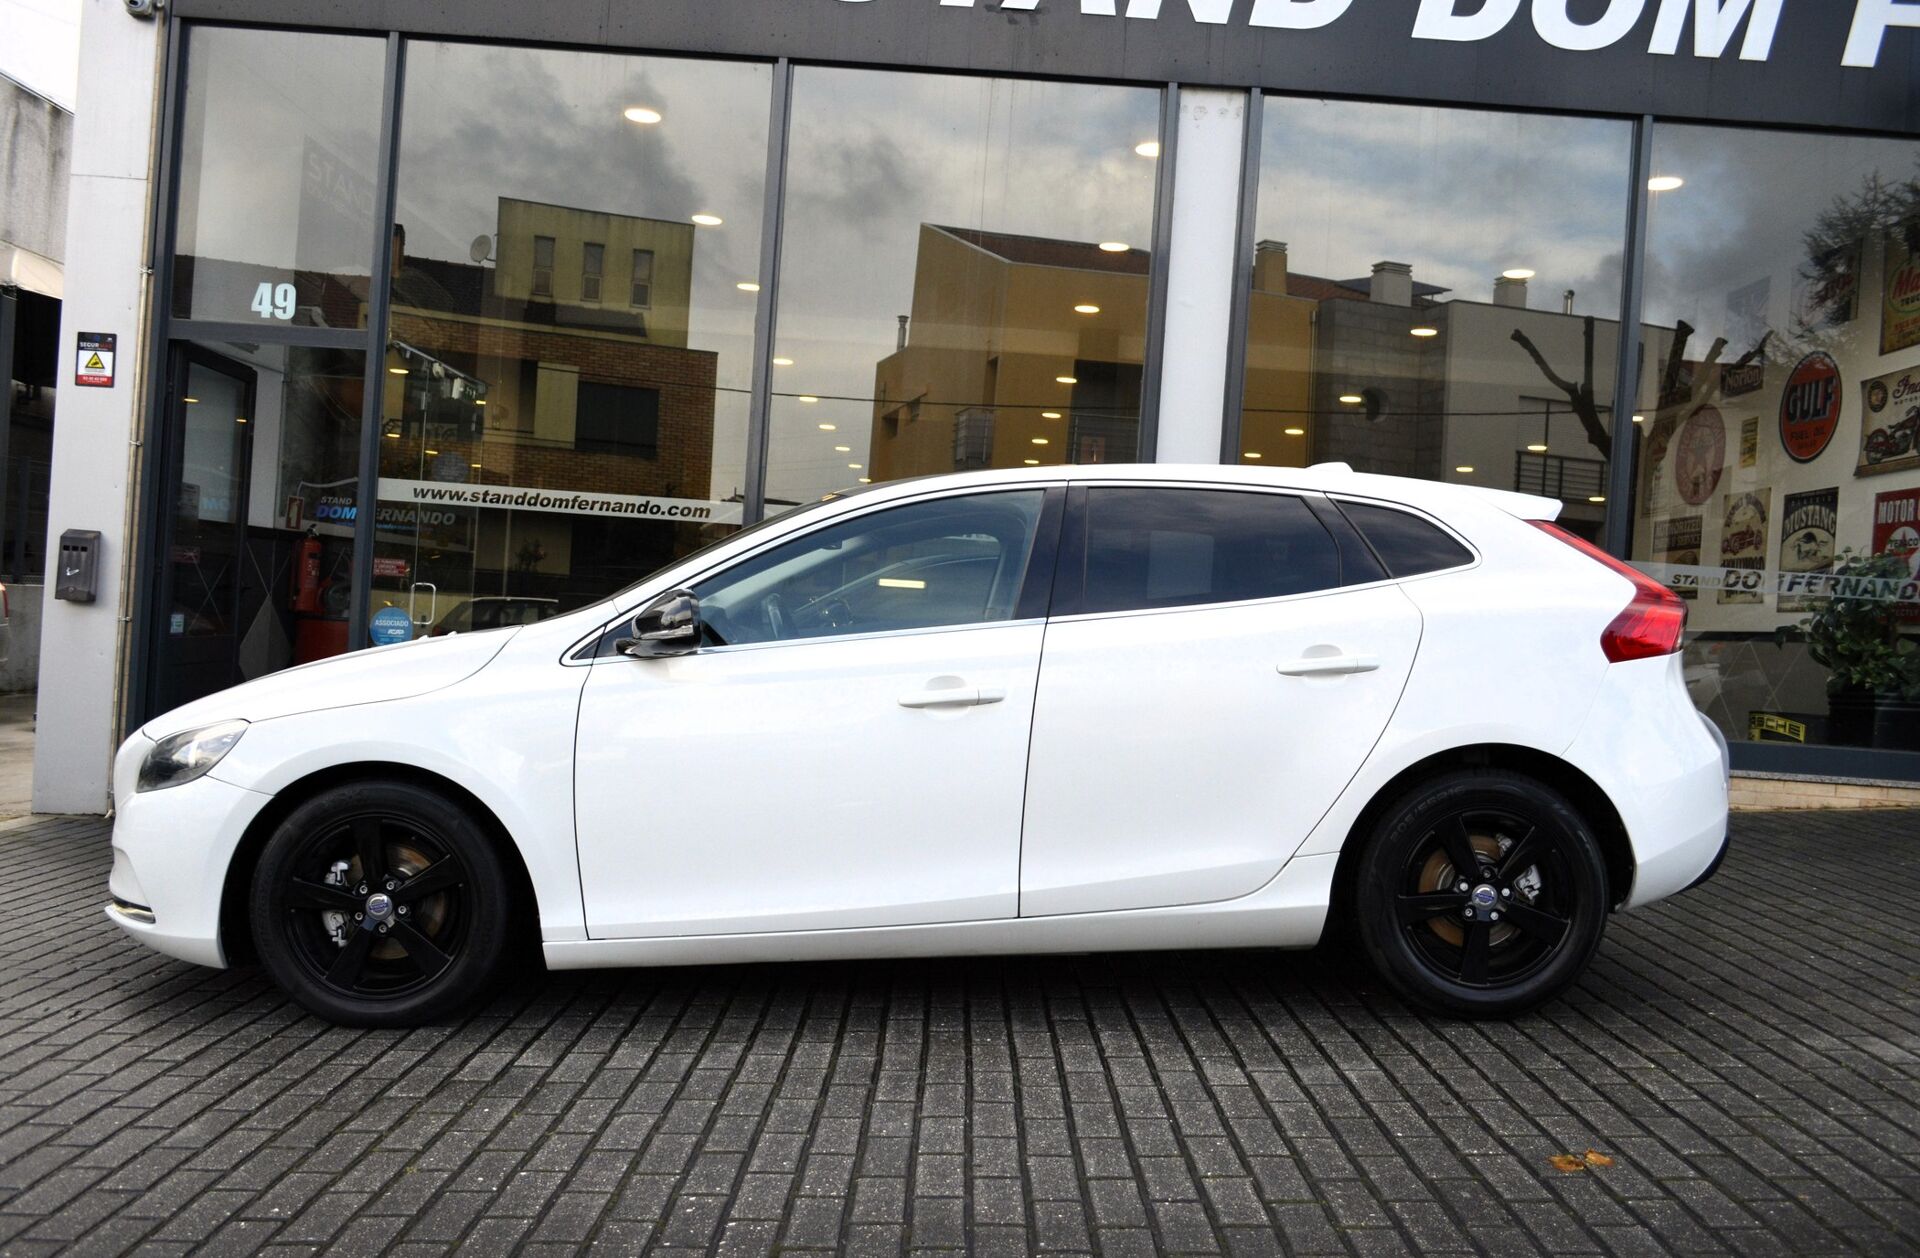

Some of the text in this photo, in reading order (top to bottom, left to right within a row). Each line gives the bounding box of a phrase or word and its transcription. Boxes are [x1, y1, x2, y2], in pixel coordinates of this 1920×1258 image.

[251, 283, 297, 320] 49
[1786, 376, 1836, 424] GULF
[314, 505, 358, 520] DOM
[320, 495, 353, 505] STAND
[411, 485, 711, 519] www.standdomfernando.com
[1878, 499, 1915, 524] MOTOR
[1783, 505, 1836, 540] MUSTANG
[1671, 574, 1721, 586] STAND
[1785, 573, 1920, 600] FERNAND
[375, 620, 409, 628] ASSOCIADO
